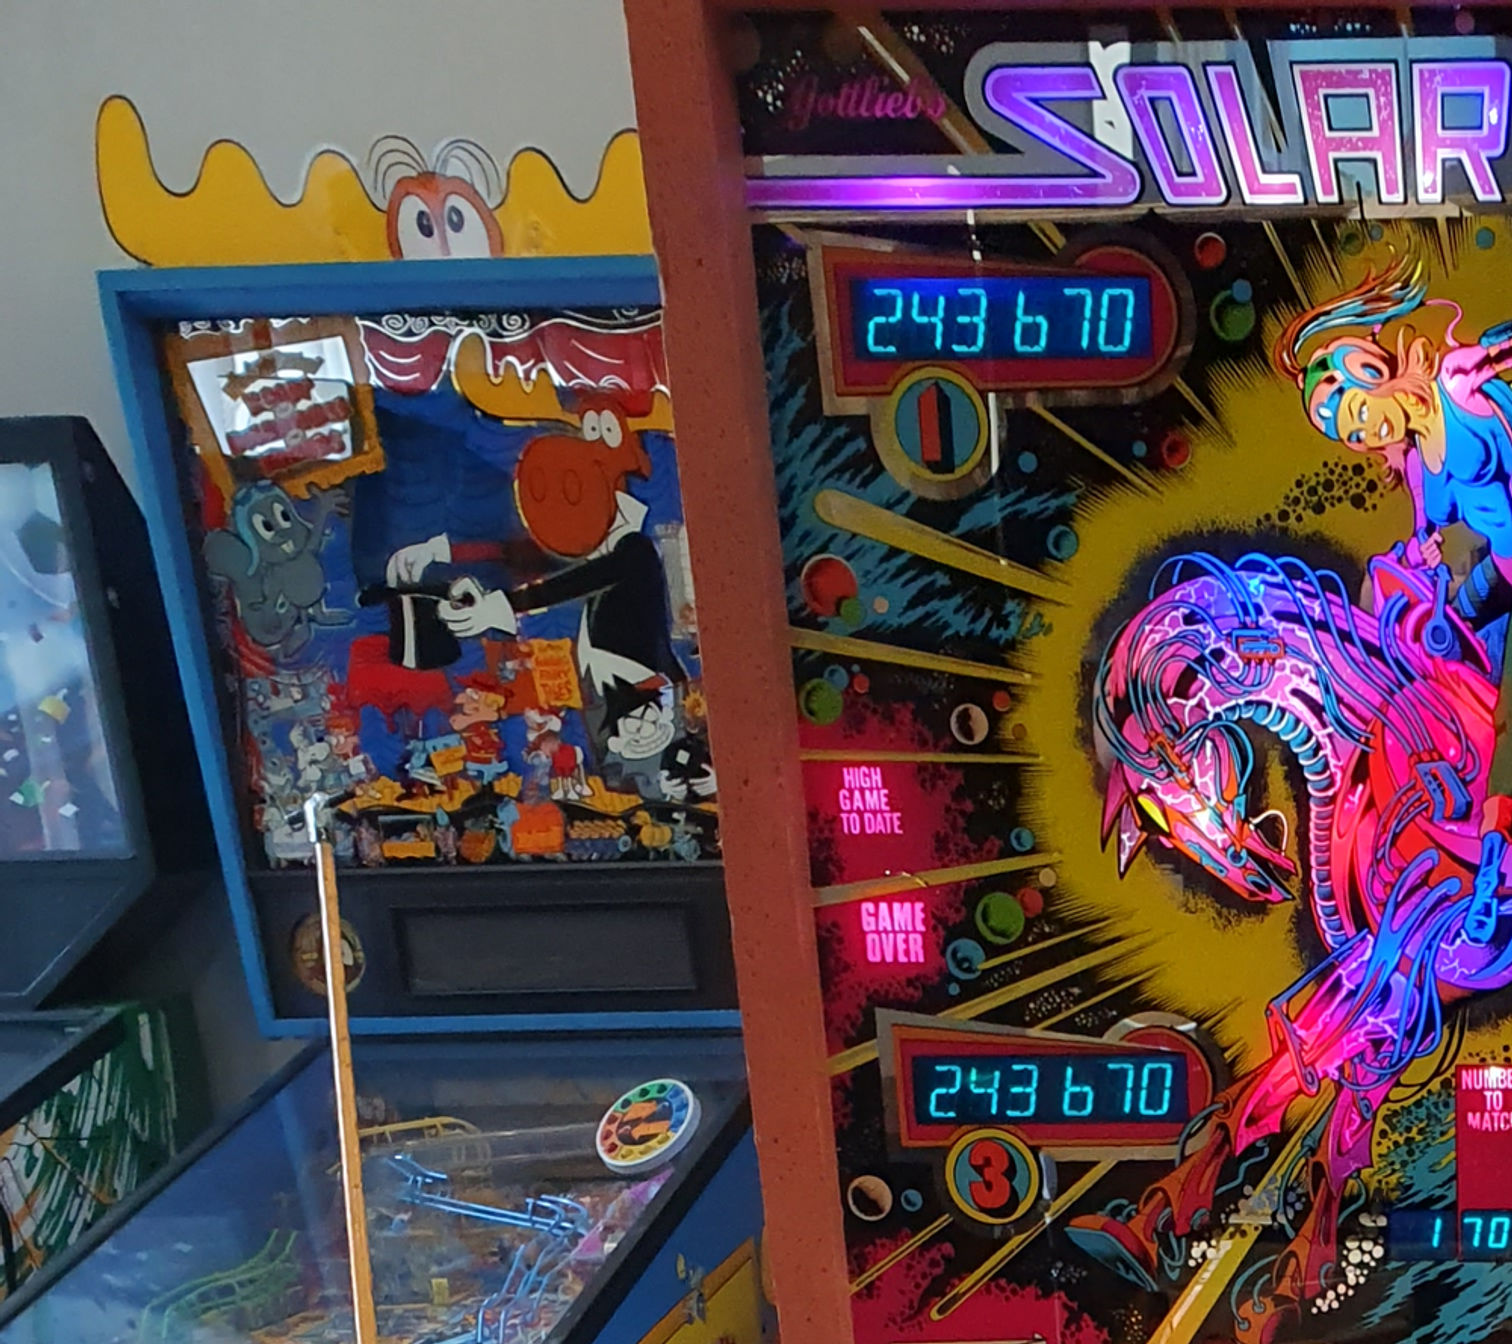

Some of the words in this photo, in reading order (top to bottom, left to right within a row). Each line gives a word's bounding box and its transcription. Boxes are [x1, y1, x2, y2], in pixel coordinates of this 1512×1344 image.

[842, 766, 883, 788] HIGH
[839, 789, 890, 811] GAME
[840, 812, 861, 835] TO
[863, 812, 903, 834] DATE
[861, 902, 926, 932] GAME
[866, 933, 925, 963] OVER
[1483, 1090, 1503, 1111] TO
[968, 1134, 1018, 1199] 3
[1462, 1216, 1511, 1248] 70
